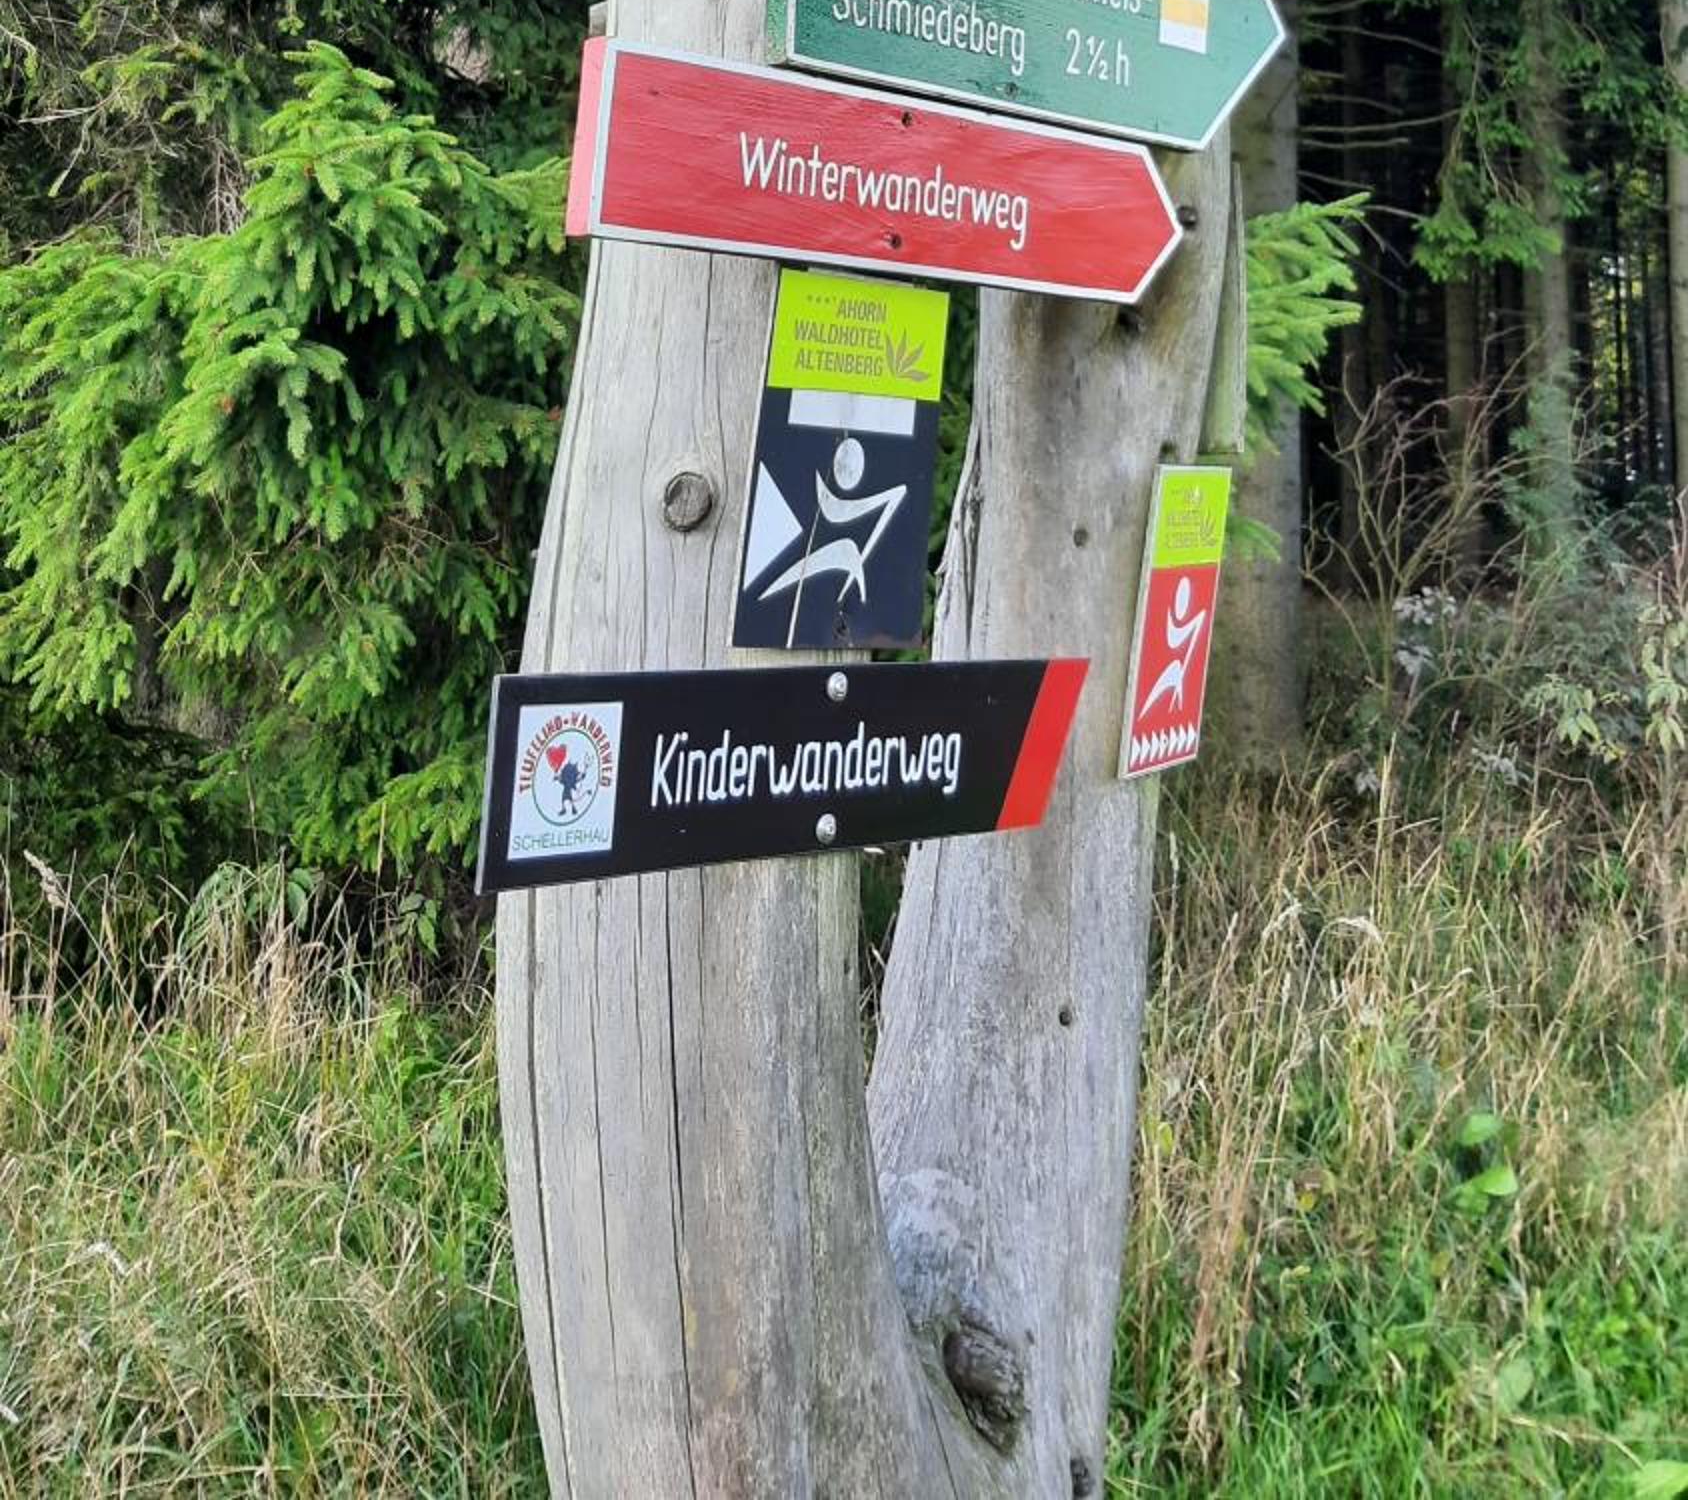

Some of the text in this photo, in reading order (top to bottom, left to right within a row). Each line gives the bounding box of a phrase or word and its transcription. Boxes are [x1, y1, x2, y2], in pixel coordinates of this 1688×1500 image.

[739, 131, 1029, 250] Winterwanderweg
[836, 299, 886, 323] AHORN
[795, 319, 884, 350] WALDHOTEL
[795, 348, 883, 377] ALTENBERG
[651, 721, 961, 807] Kinderwanderweg
[512, 828, 609, 851] SCHELLERHAU
